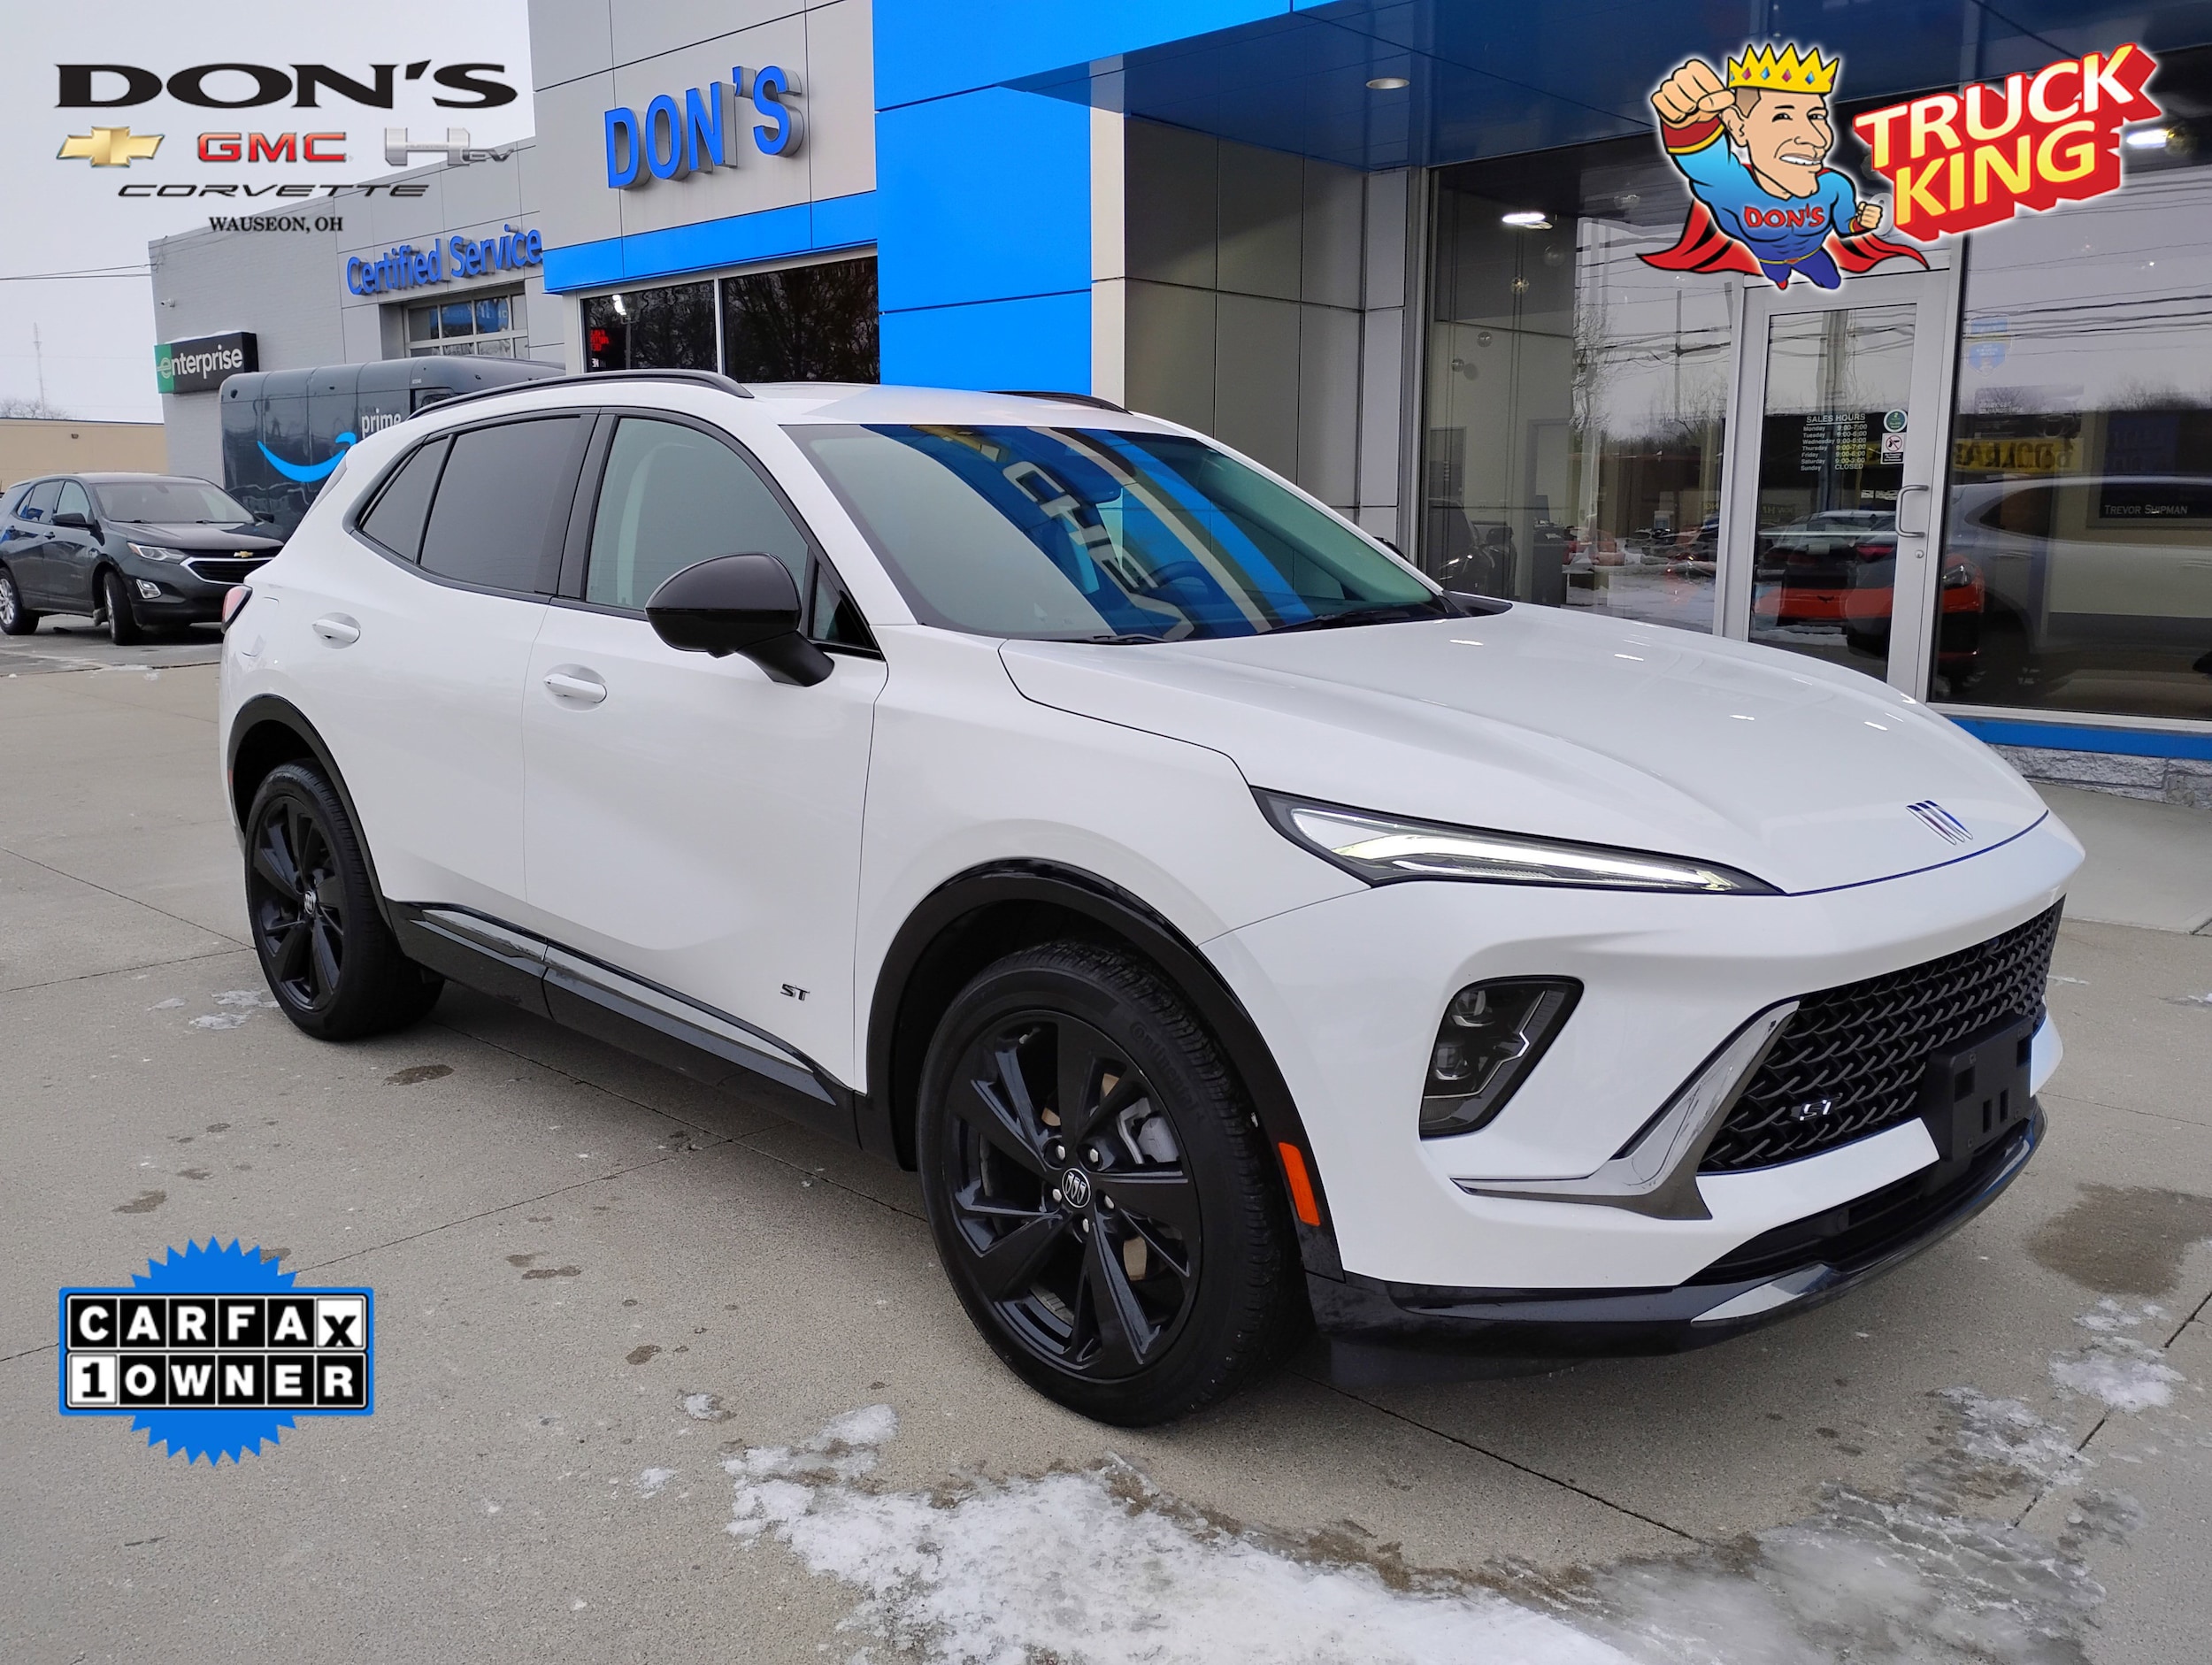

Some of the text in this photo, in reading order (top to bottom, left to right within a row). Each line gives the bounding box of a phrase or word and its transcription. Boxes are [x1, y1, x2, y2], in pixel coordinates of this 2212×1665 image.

[604, 65, 793, 189] DON'S
[346, 224, 543, 295] Certified Service
[157, 344, 243, 380] enterprise
[361, 408, 402, 439] prime
[2104, 504, 2141, 515] TREVOR
[780, 983, 810, 1001] ST
